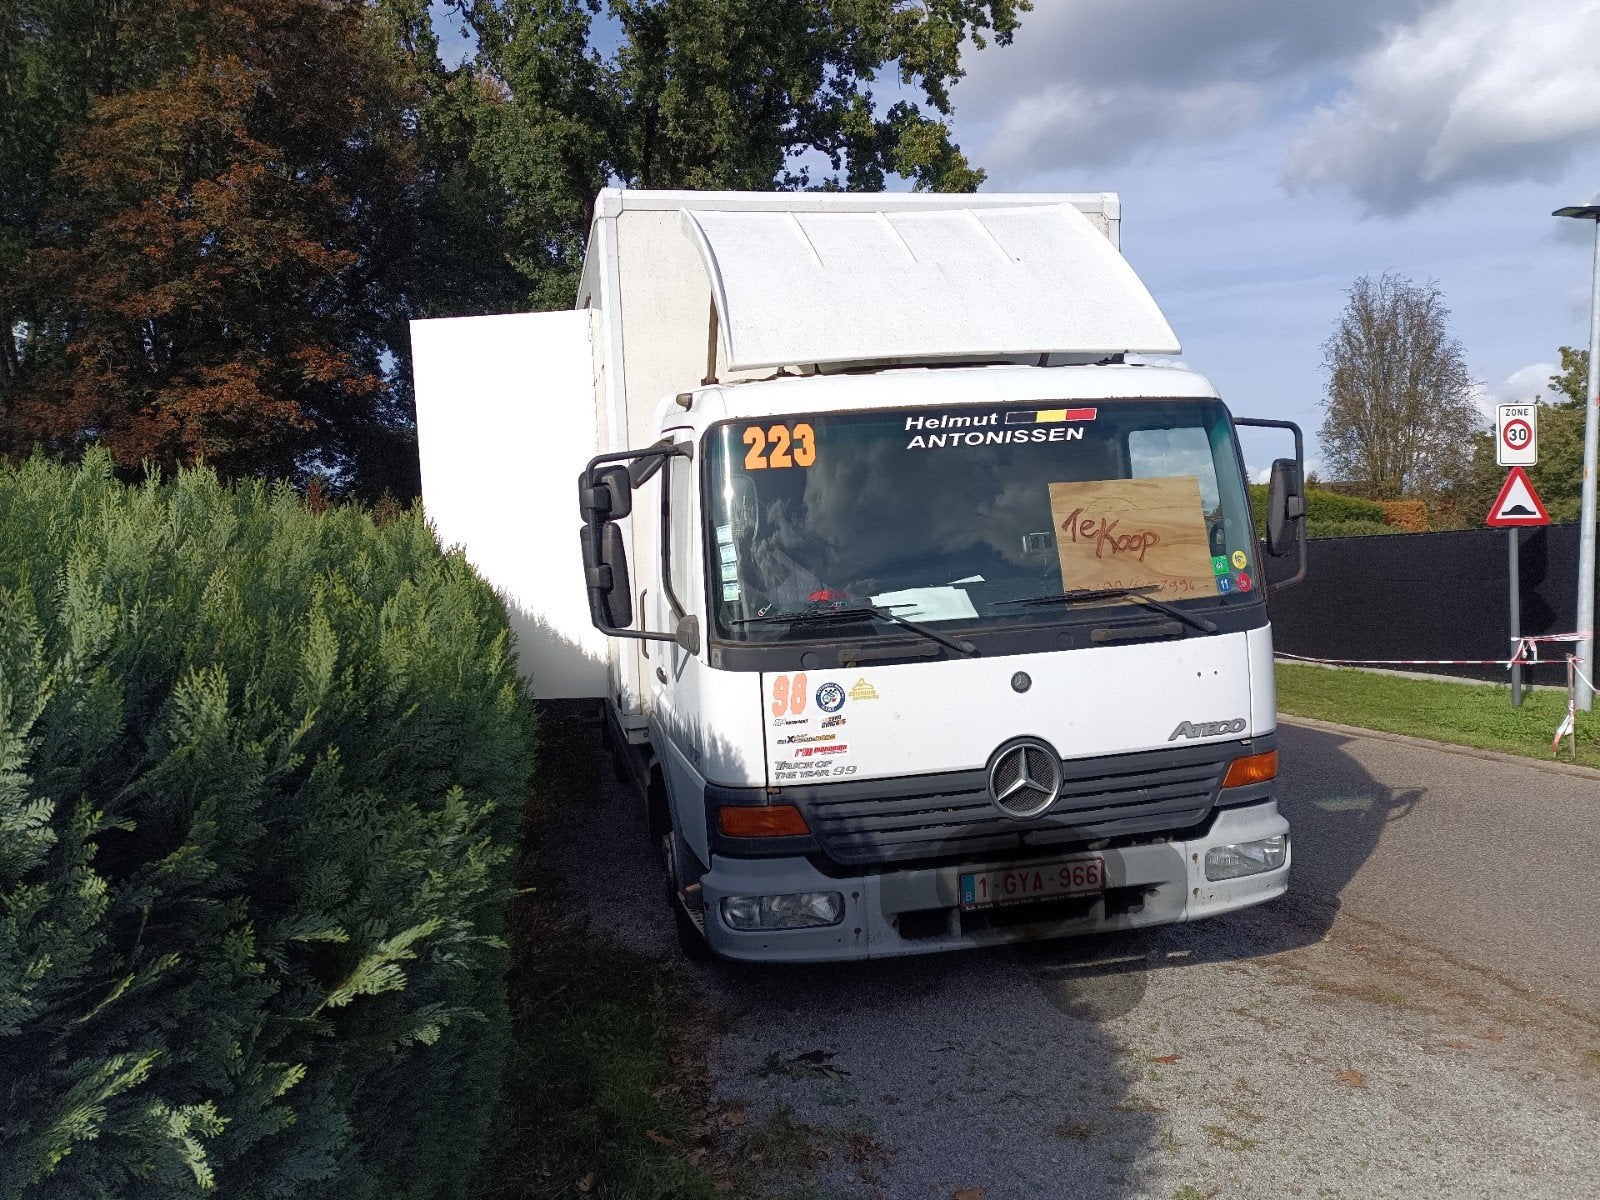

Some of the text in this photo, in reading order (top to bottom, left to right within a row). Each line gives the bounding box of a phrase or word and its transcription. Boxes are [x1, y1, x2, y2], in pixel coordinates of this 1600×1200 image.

[904, 411, 999, 431] Helmut
[1505, 408, 1529, 417] ZONE
[906, 427, 1085, 450] ANTONISSEN
[1509, 428, 1527, 441] 30
[742, 423, 816, 470] 223
[1061, 508, 1160, 563] Te Koop
[772, 672, 808, 717] 98
[799, 769, 830, 779] YEAR
[832, 765, 858, 776] 99
